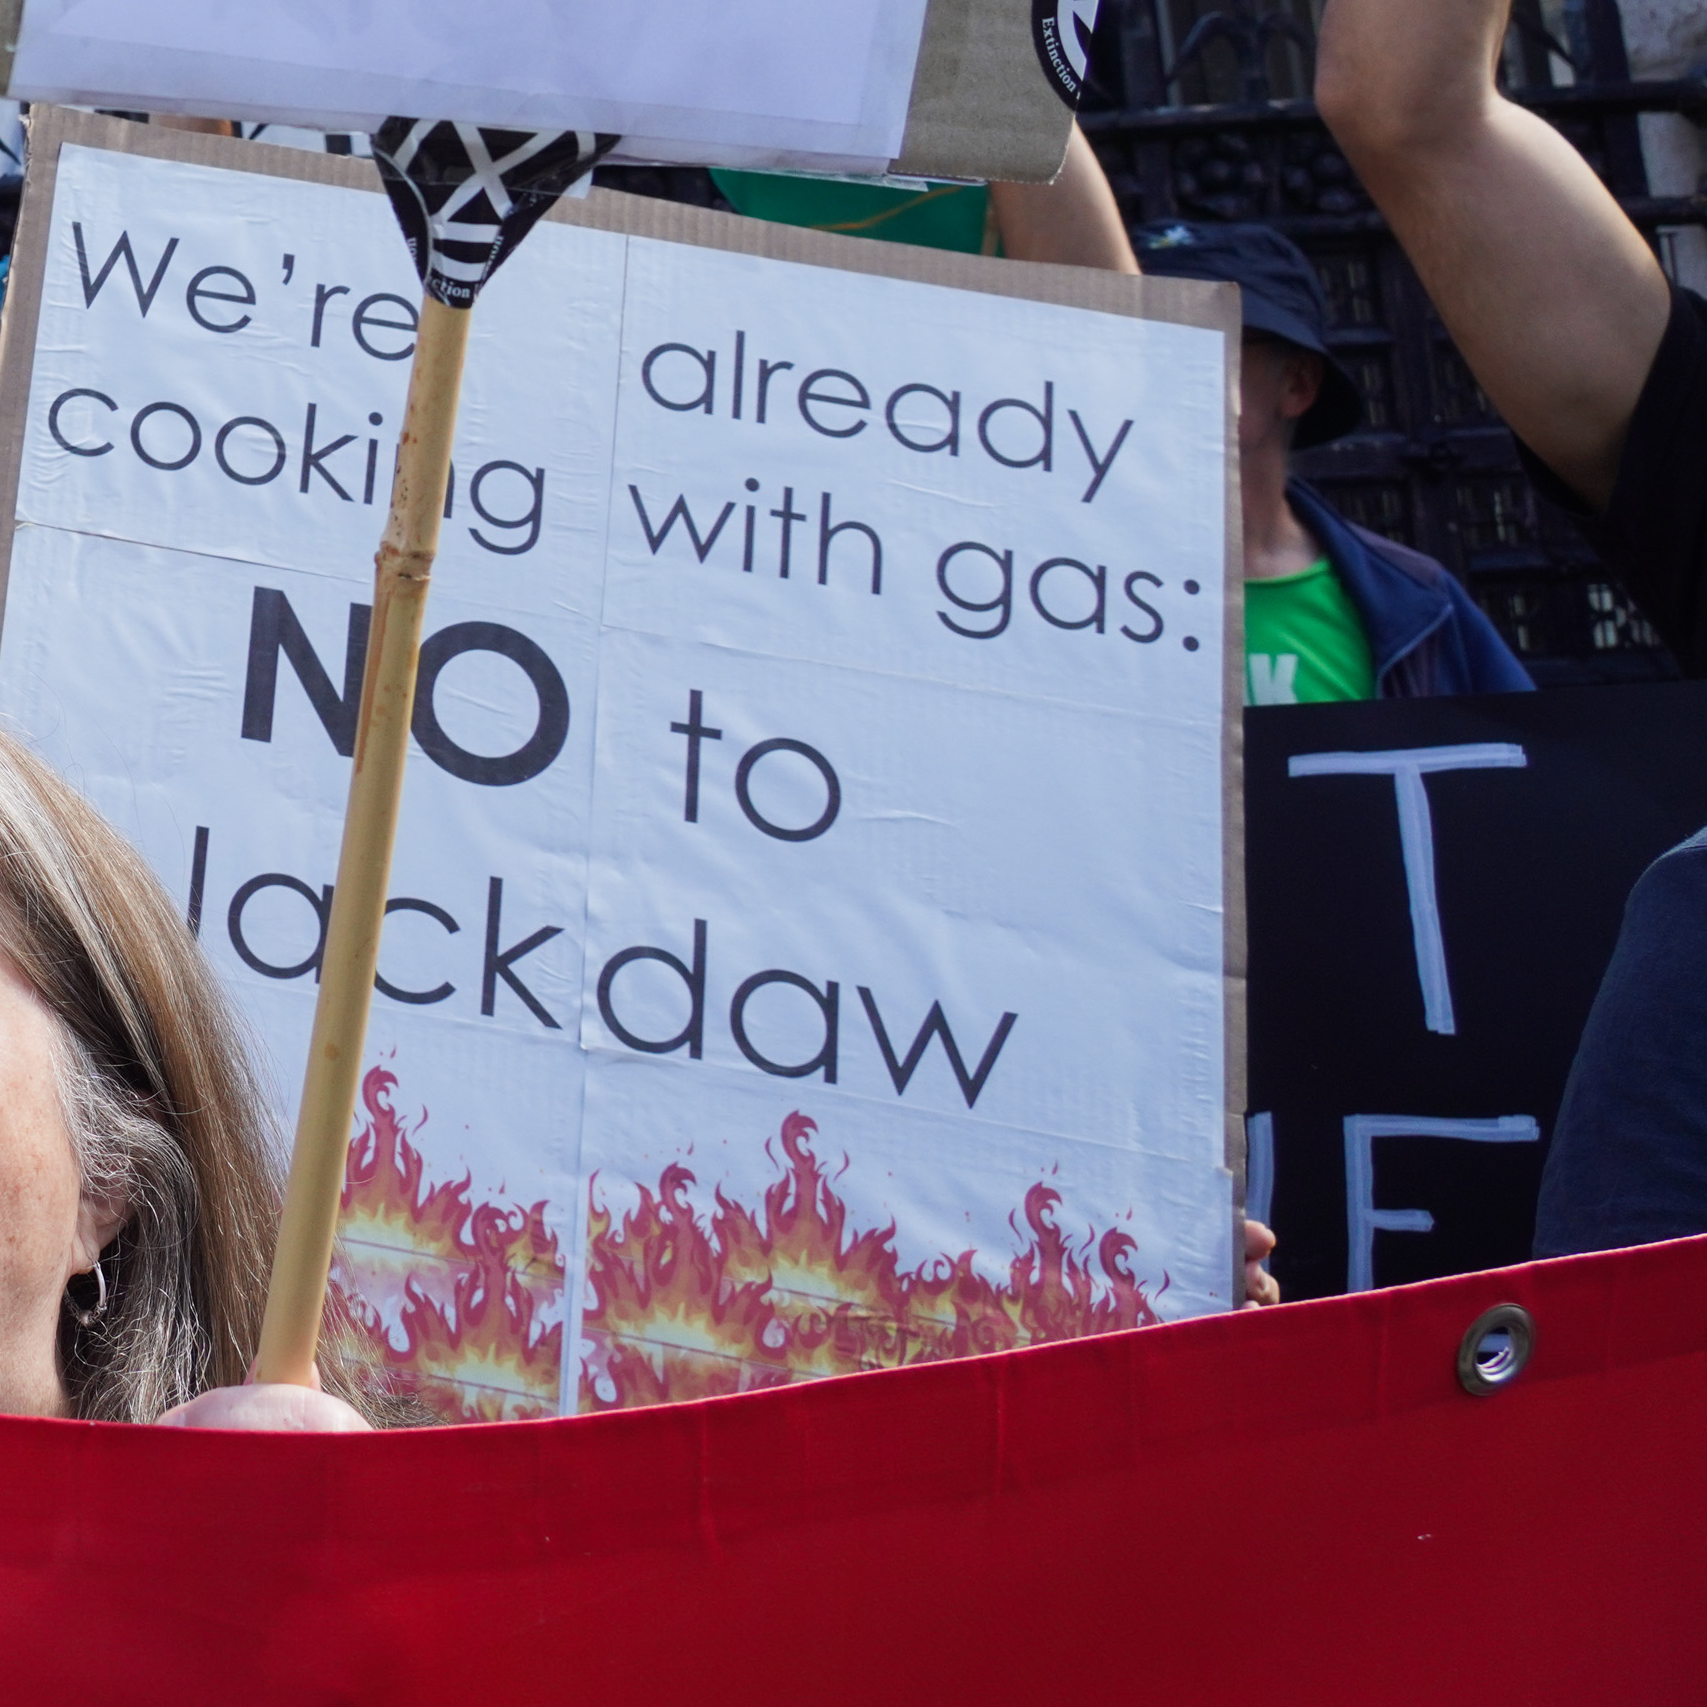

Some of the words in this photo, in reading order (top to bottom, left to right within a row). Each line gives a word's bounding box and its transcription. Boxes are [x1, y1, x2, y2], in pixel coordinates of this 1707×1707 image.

[1042, 17, 1077, 94] Extinction
[73, 220, 419, 361] We're
[642, 330, 1133, 503] already
[629, 477, 882, 595] with
[937, 540, 1200, 652] gas:
[242, 586, 570, 787] NO
[670, 690, 841, 843] to
